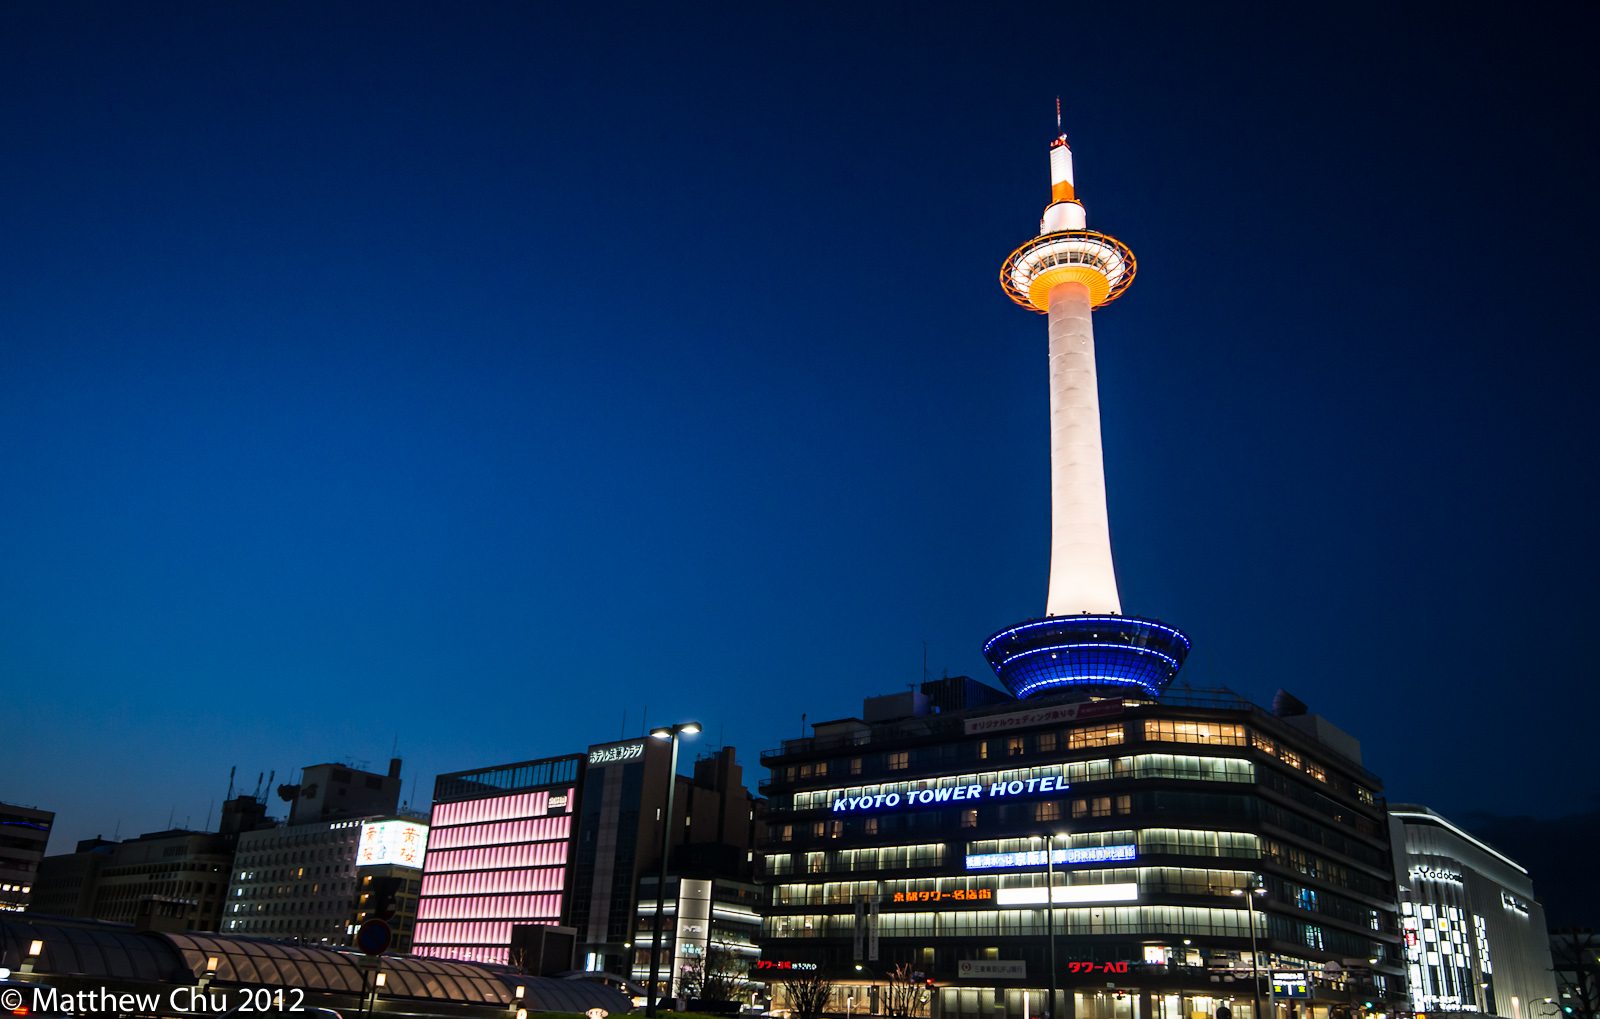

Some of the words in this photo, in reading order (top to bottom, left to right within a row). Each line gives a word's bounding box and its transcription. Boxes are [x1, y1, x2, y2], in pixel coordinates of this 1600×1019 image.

[833, 792, 901, 812] KYOTO
[906, 783, 982, 806] TOWER
[988, 775, 1071, 798] HOTEL
[893, 888, 992, 903] 京都タワー名店街
[1067, 961, 1128, 974] タワー入口
